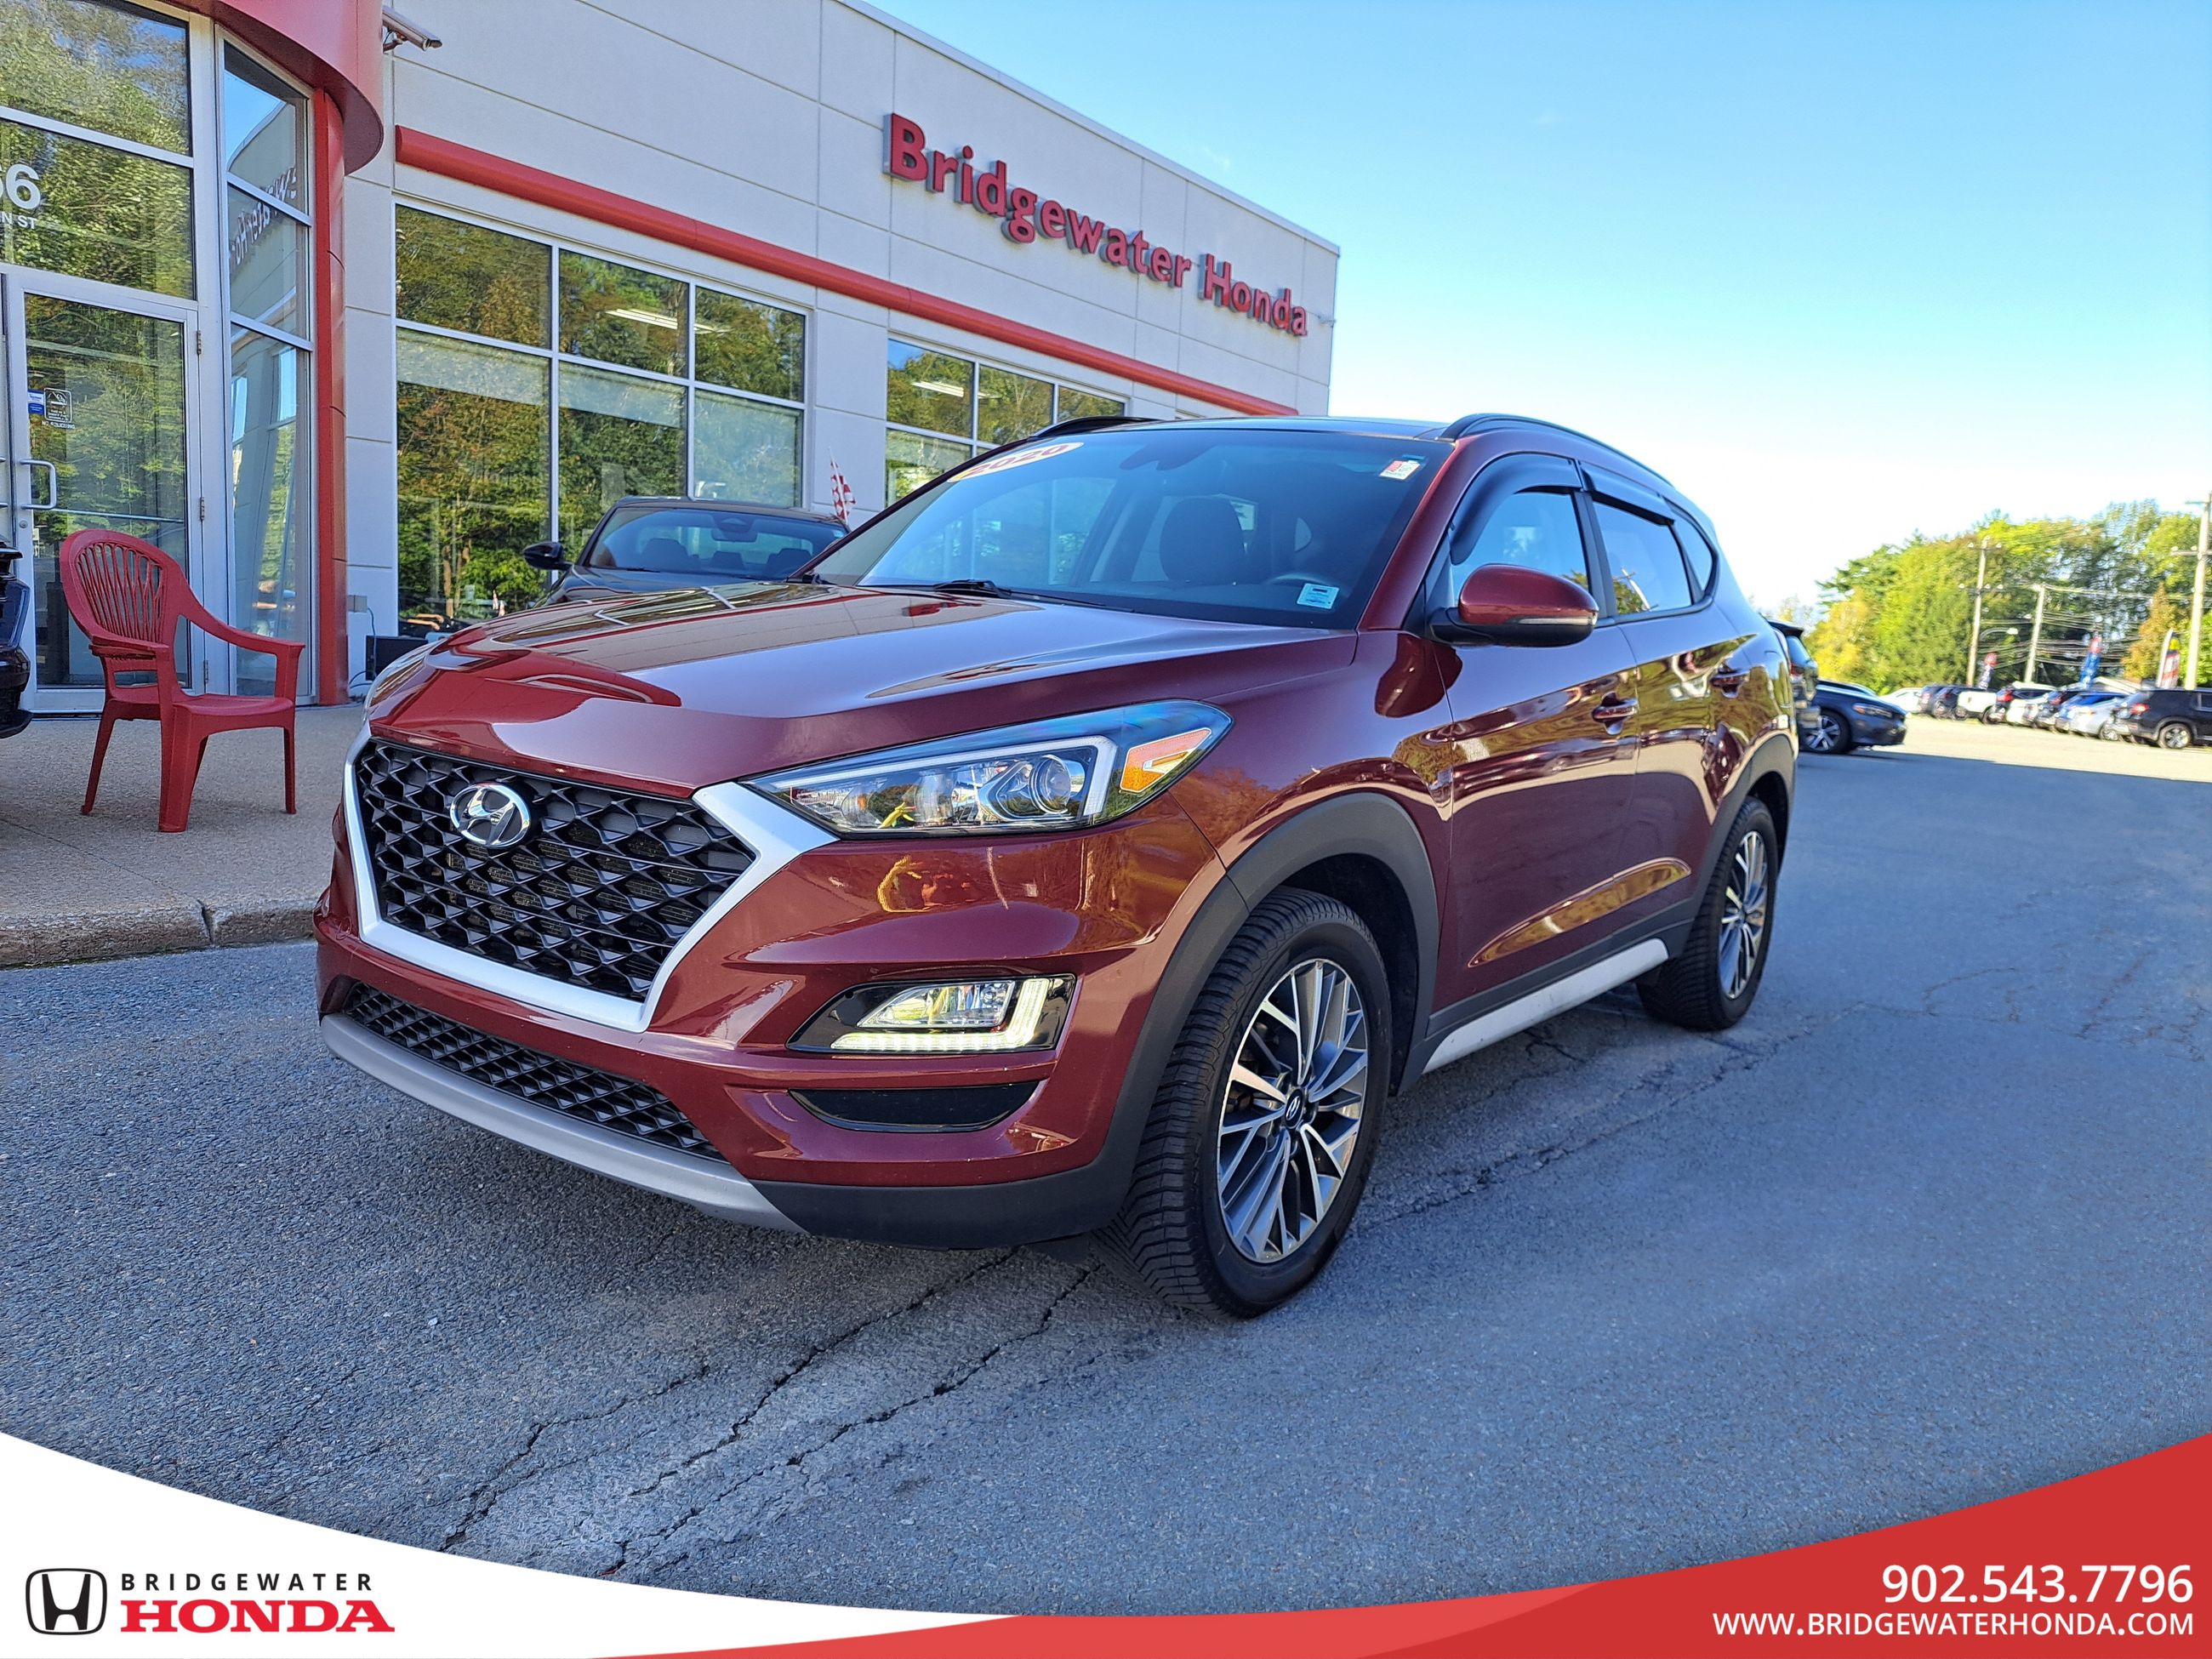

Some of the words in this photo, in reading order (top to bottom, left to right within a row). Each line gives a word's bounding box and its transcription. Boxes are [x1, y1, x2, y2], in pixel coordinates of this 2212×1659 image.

[0, 163, 41, 209] 6
[18, 214, 37, 230] ST
[884, 112, 1192, 288] Bridgewater
[1199, 253, 1308, 337] Honda
[961, 444, 1069, 479] 2020
